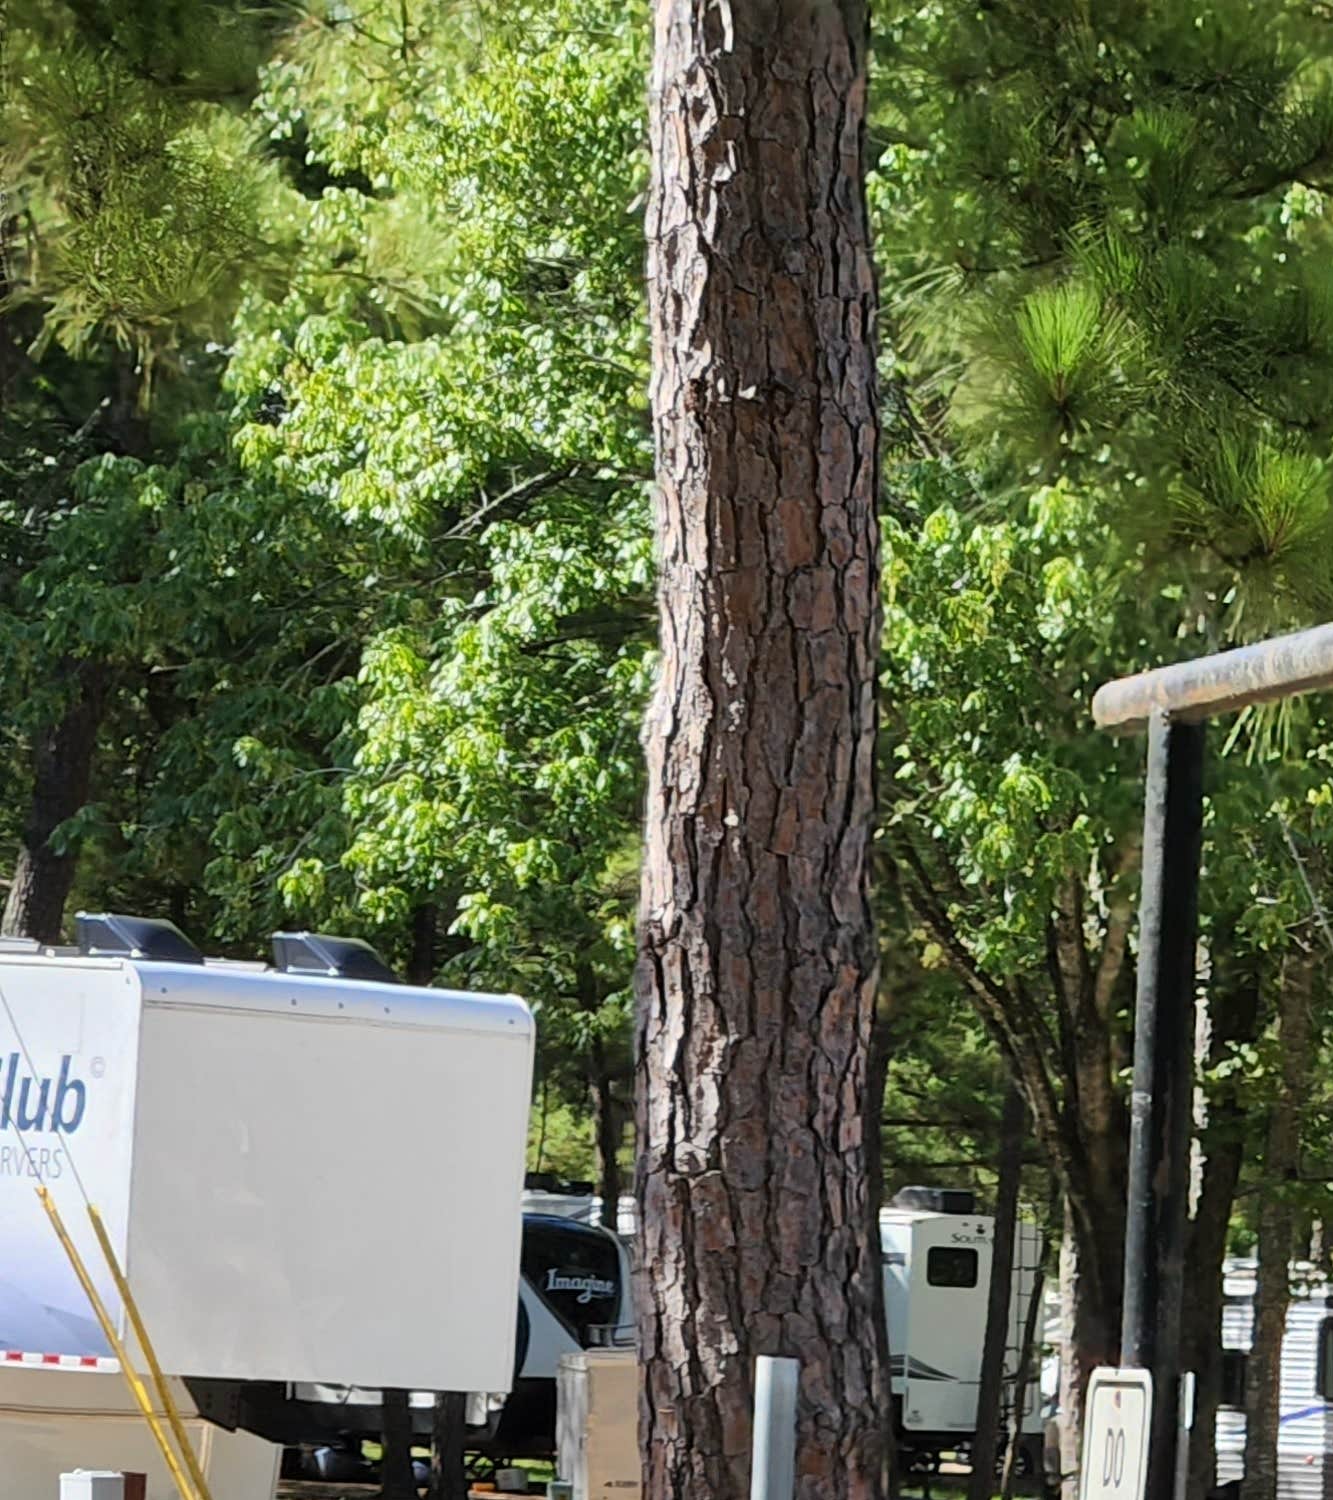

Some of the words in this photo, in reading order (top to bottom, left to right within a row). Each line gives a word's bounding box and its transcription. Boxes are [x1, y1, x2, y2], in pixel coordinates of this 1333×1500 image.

[0, 1052, 86, 1134] lub
[545, 1268, 616, 1304] Imagine
[1103, 1428, 1125, 1488] DO
